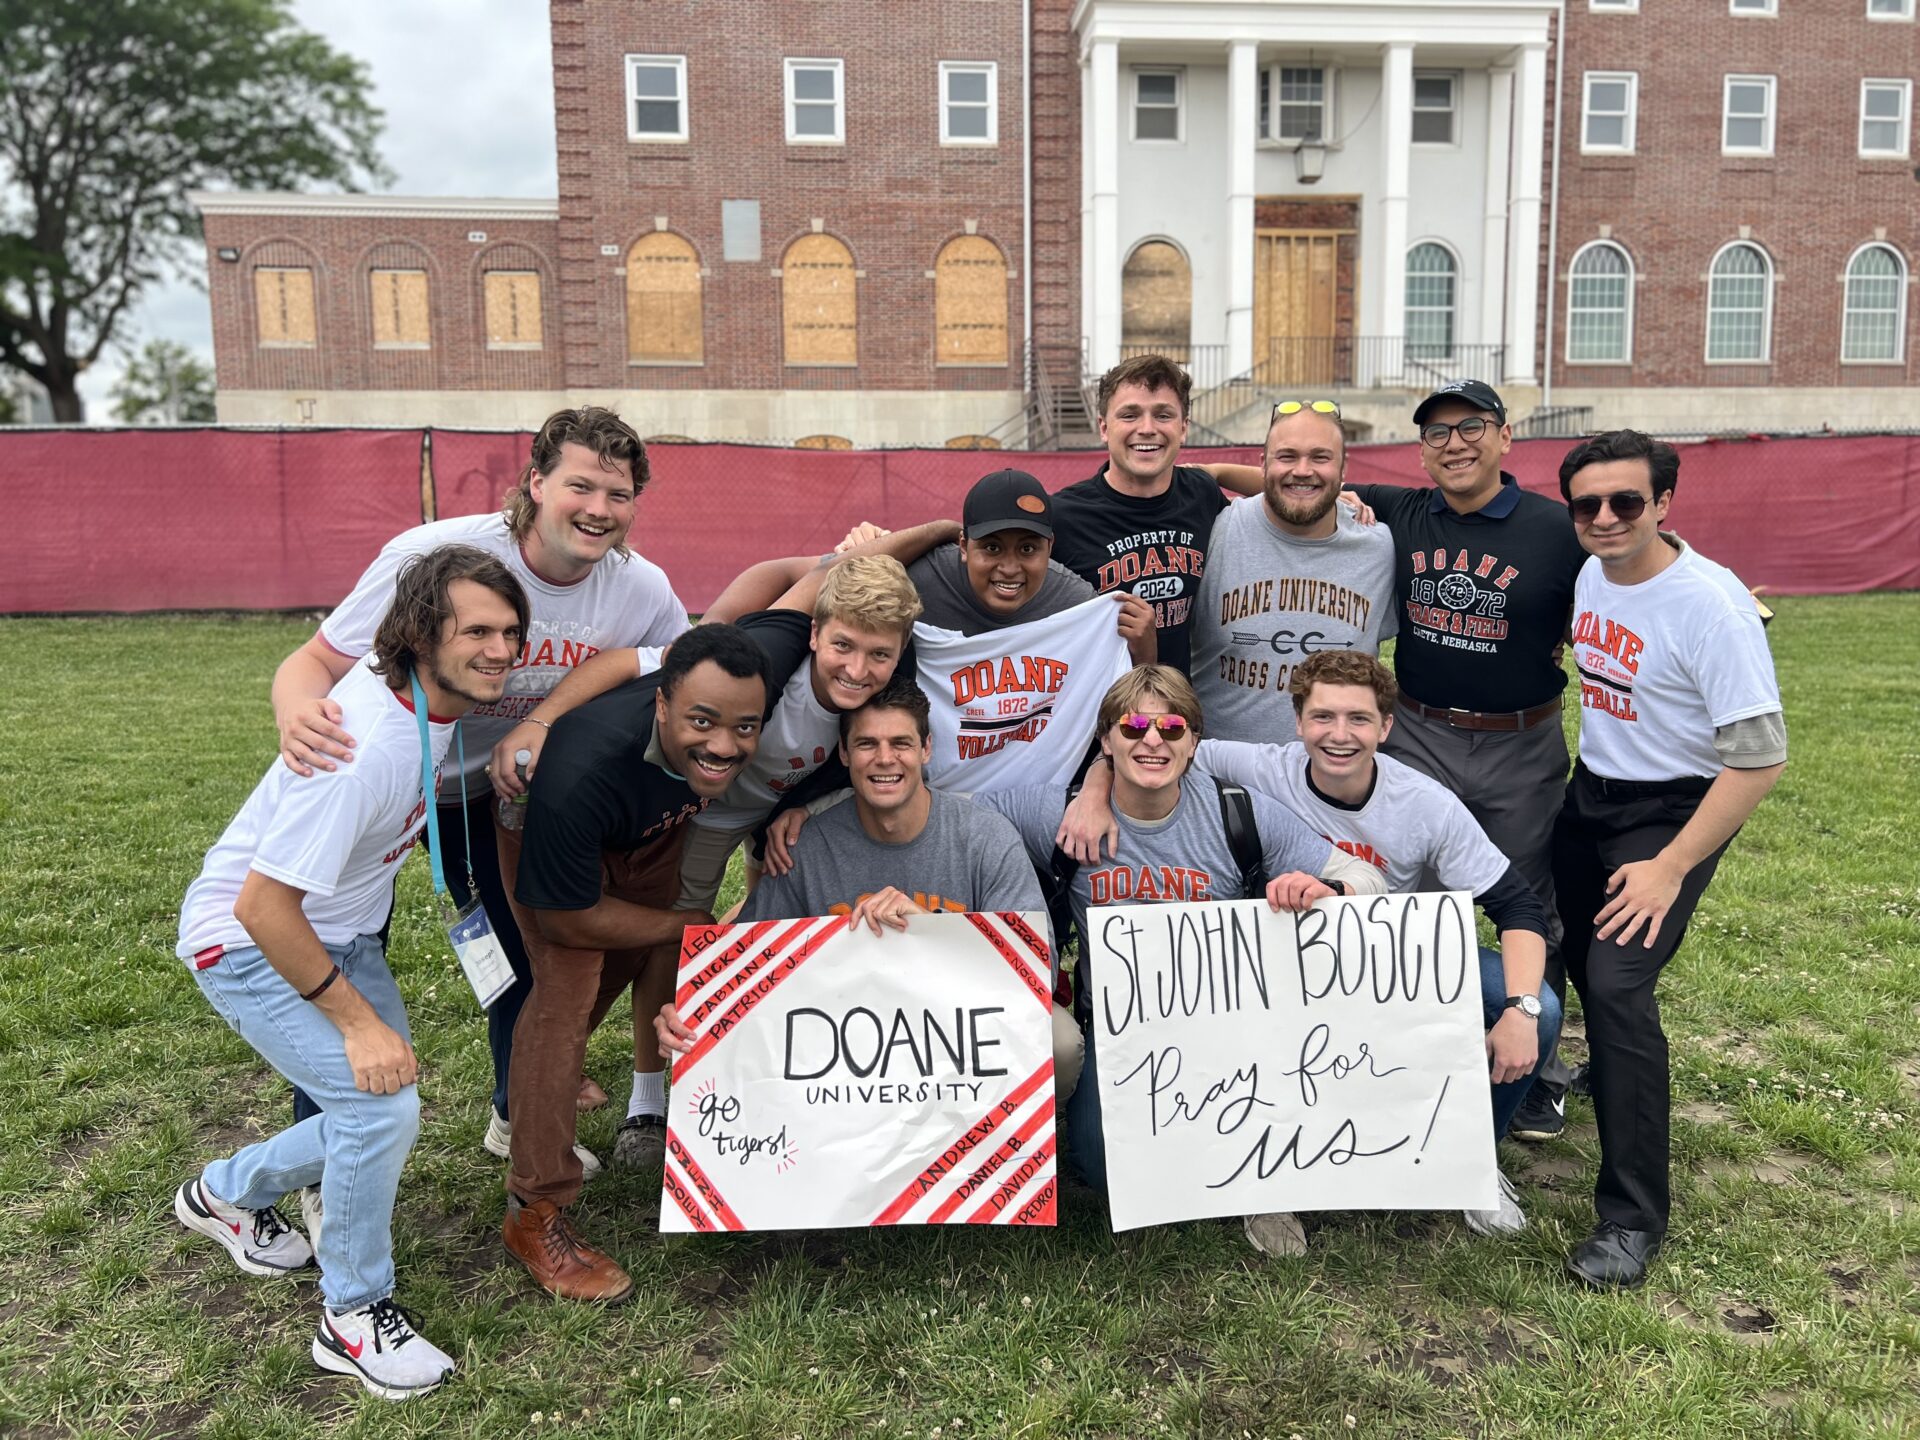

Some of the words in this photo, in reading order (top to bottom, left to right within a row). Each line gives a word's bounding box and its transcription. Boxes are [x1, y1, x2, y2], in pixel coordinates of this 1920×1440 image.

[1106, 530, 1177, 557] PROPERTY
[1180, 531, 1194, 545] OF
[1098, 546, 1204, 594] DOANE
[1139, 579, 1177, 599] 2024
[1411, 548, 1519, 590] DOANE
[1166, 595, 1193, 627] FIEL
[1220, 580, 1273, 626] DOANE
[1278, 578, 1371, 632] UNIVERSITY
[1450, 585, 1464, 598] 72
[1406, 600, 1451, 631] TRACK
[1450, 612, 1463, 634] &
[1463, 614, 1509, 640] FIELD
[1270, 630, 1325, 655] CC
[1441, 635, 1498, 653] NEBRASKA
[950, 656, 1069, 707] DOANE
[1219, 655, 1269, 690] CROSS
[997, 697, 1029, 715] 1872
[1582, 679, 1638, 722] TBALL
[1332, 838, 1389, 874] ANE
[1088, 864, 1212, 906] DOANE
[683, 929, 718, 960] LEO
[1002, 913, 1050, 962] CHRIS
[1157, 906, 1270, 1018] JOHN
[1293, 894, 1467, 1006] BOSCO
[690, 956, 735, 990] NICK
[736, 941, 749, 955] J.
[694, 959, 760, 1024] FABIAN
[709, 970, 780, 1040] PATRICK
[783, 1006, 1009, 1080] DOANE
[806, 1080, 984, 1106] UNIVERSITY
[1113, 1046, 1276, 1136] Pray
[1281, 1023, 1408, 1107] for
[698, 1092, 741, 1137] go
[918, 1115, 997, 1193] ANDREW
[1000, 1099, 1019, 1116] B.
[956, 1151, 1007, 1201] DANIEL
[990, 1164, 1034, 1212] DAVID
[1018, 1187, 1054, 1225] PEDRO
